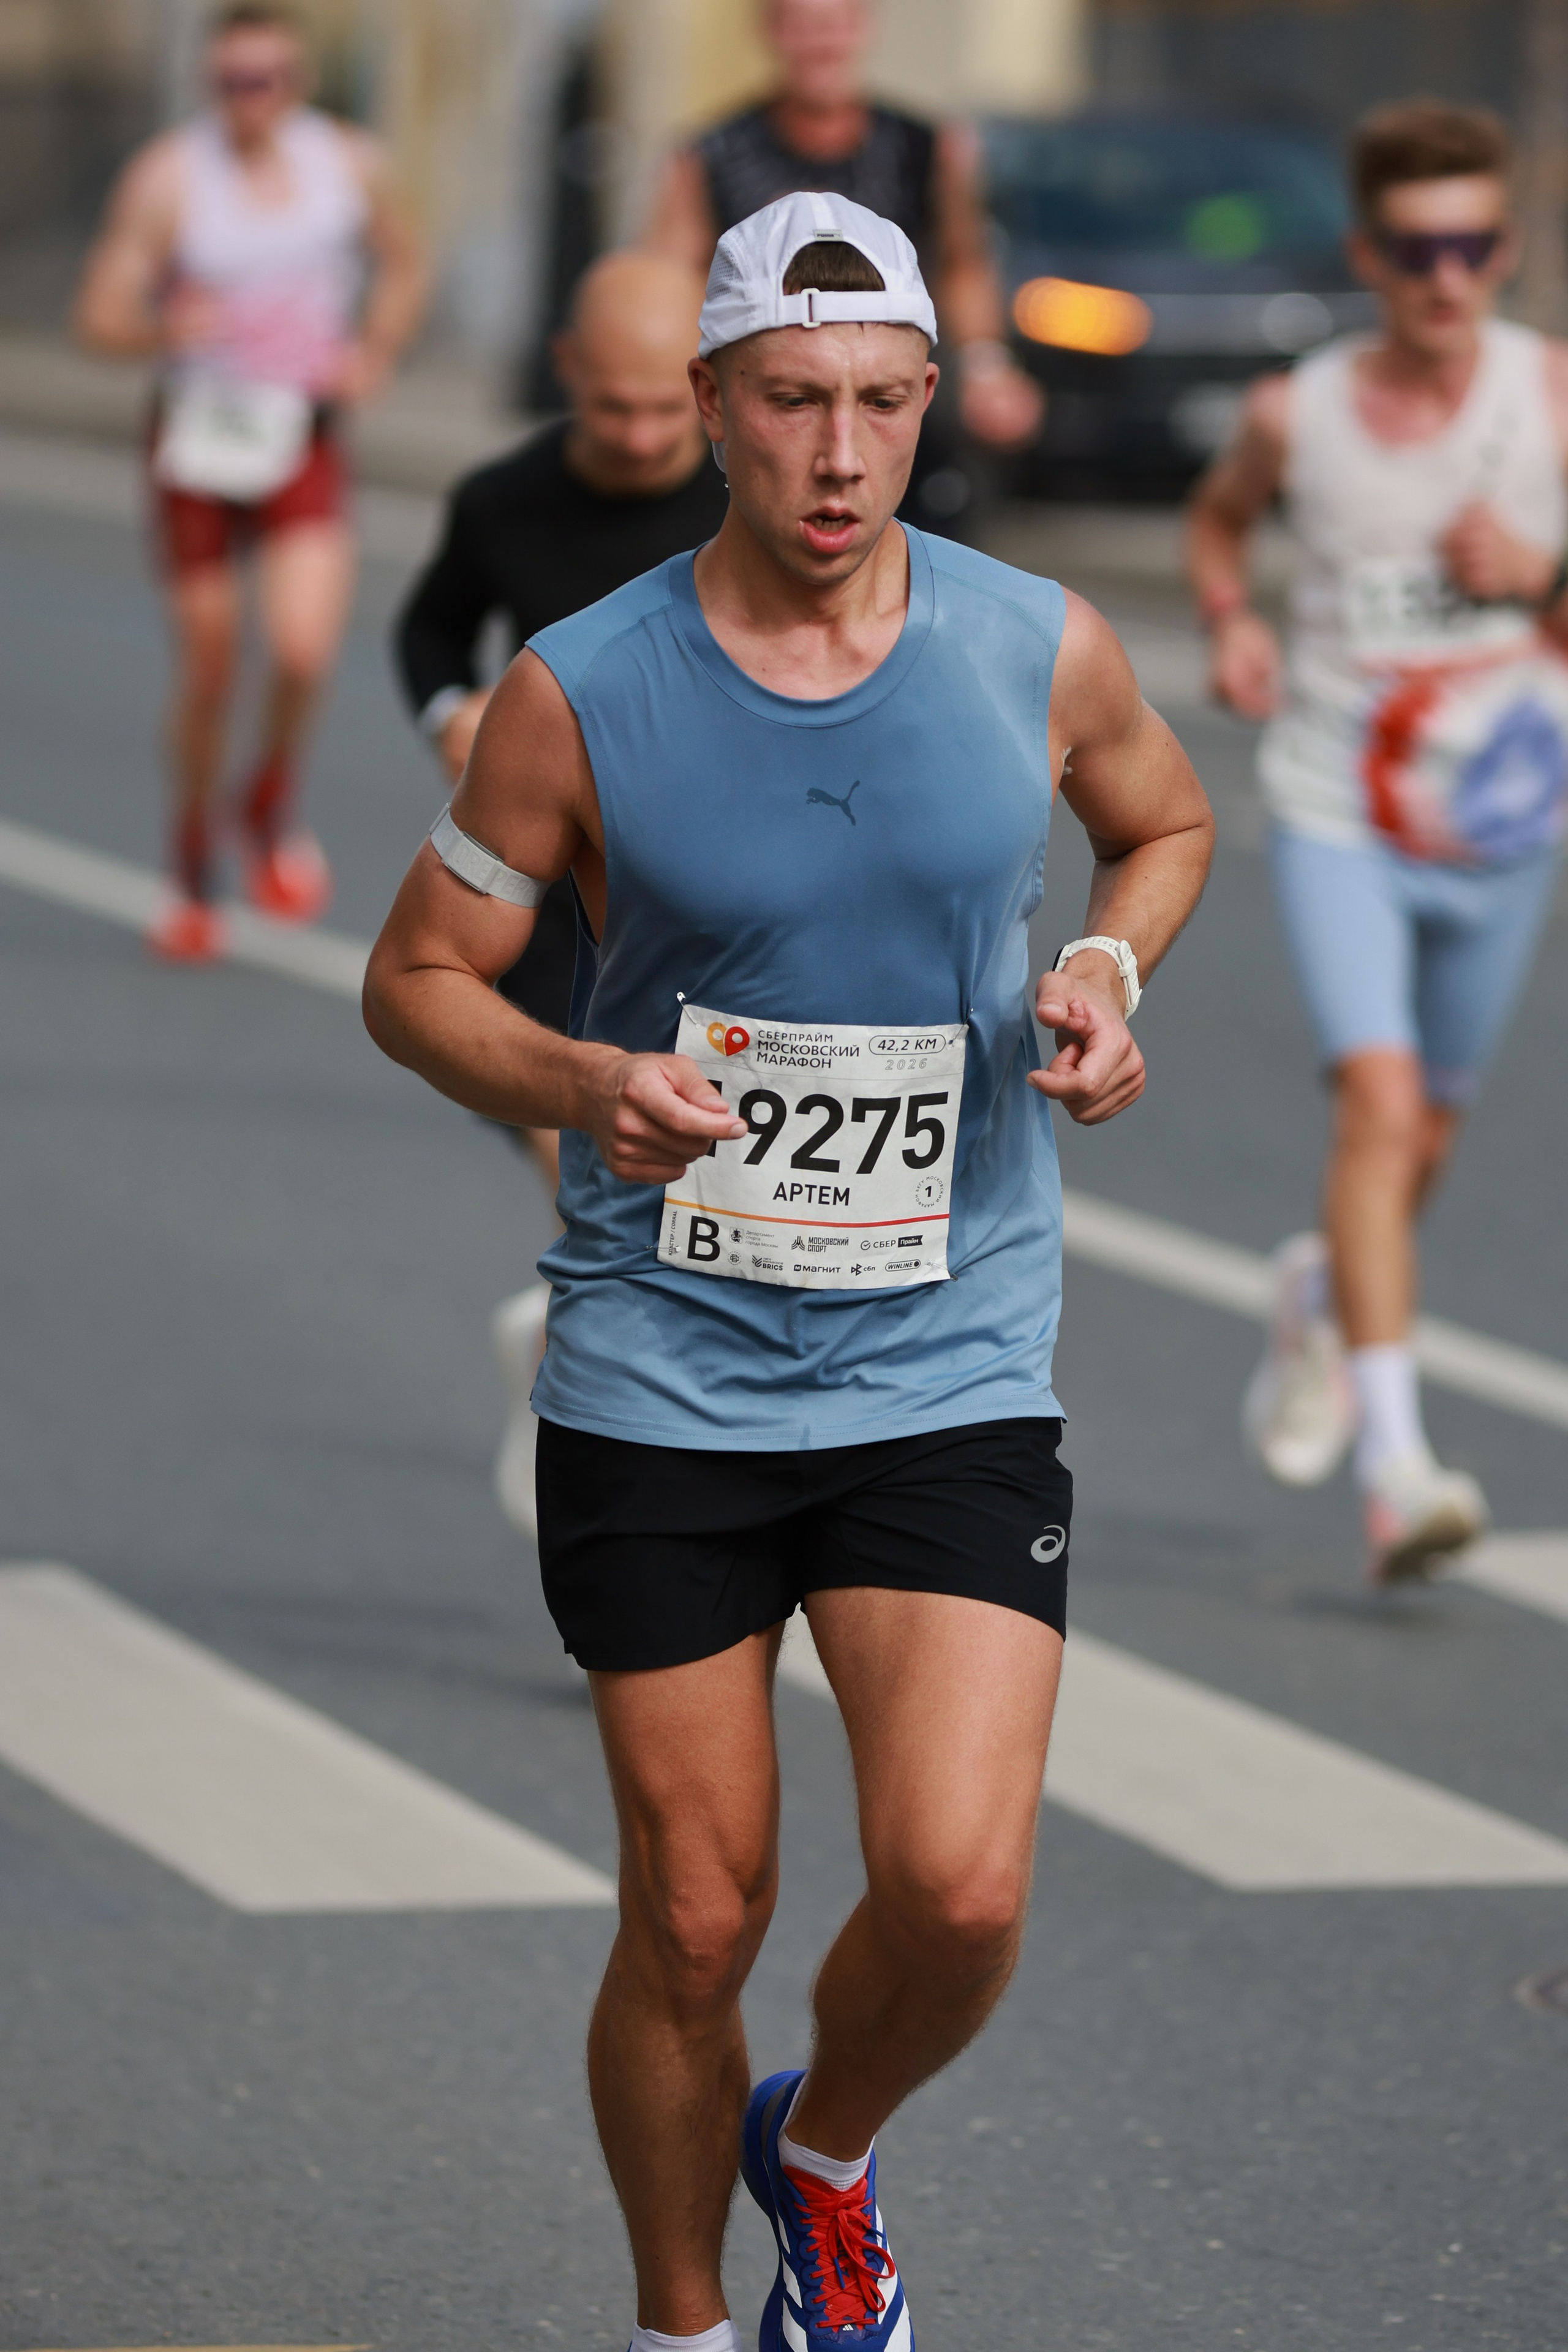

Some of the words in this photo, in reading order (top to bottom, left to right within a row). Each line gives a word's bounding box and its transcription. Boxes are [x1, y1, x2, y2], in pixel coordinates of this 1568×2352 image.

[758, 1030, 833, 1042] СБЕРПРАЙМ
[758, 1040, 859, 1057] МОСКОВСКИЙ
[878, 1039, 909, 1052] 42,2
[756, 1052, 832, 1068] МАРАФОН
[885, 1058, 928, 1071] 2026
[772, 1182, 850, 1206] АРТЕМ
[925, 1186, 932, 1197] 1
[808, 1237, 849, 1246] МОСКОВСКИЙ
[873, 1240, 896, 1248] СБЕР
